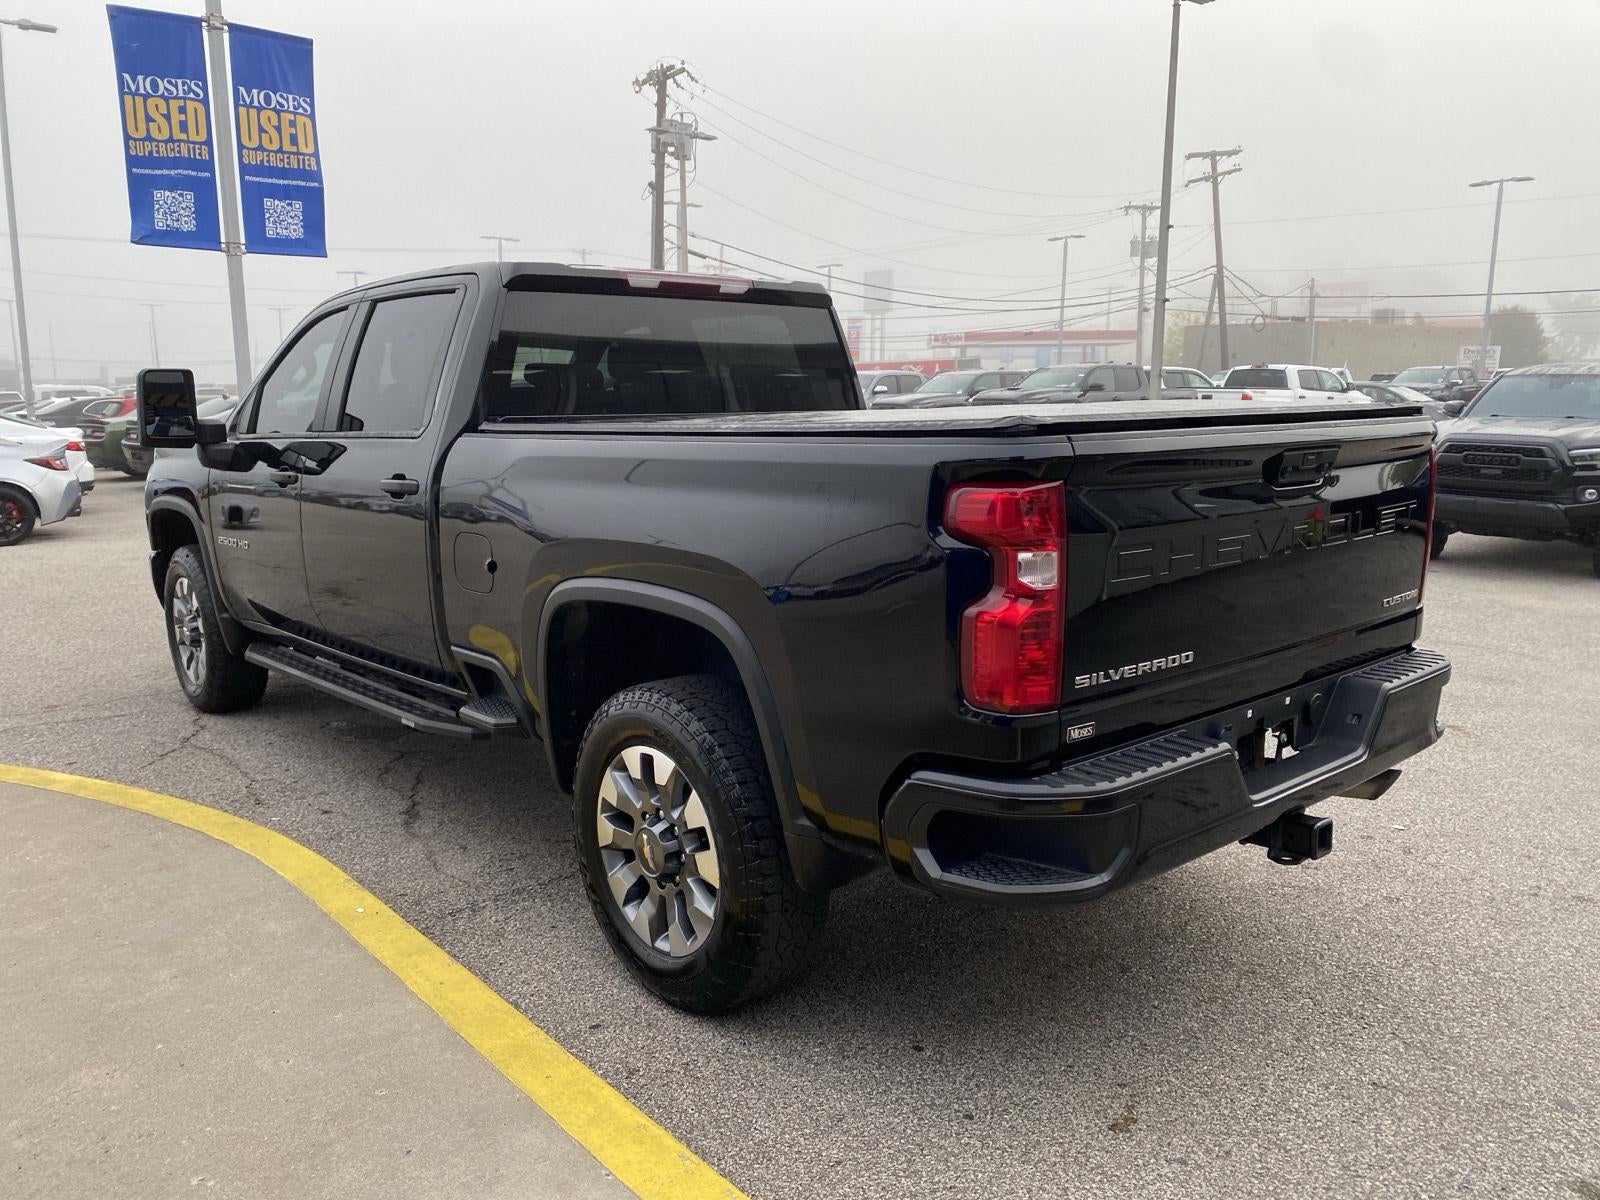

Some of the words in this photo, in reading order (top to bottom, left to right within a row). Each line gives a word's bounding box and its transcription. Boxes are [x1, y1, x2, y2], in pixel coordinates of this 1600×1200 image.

[122, 72, 204, 100] MOSES
[237, 86, 311, 115] MOSES
[124, 94, 208, 142] USED
[238, 106, 315, 154] USED
[128, 140, 210, 161] SUPERCENTER
[242, 149, 318, 171] SUPERCENTER
[1467, 454, 1517, 466] TOYOTA
[217, 535, 237, 548] 2500
[1383, 589, 1419, 607] CUSTOM
[1074, 651, 1194, 689] SILVERADO
